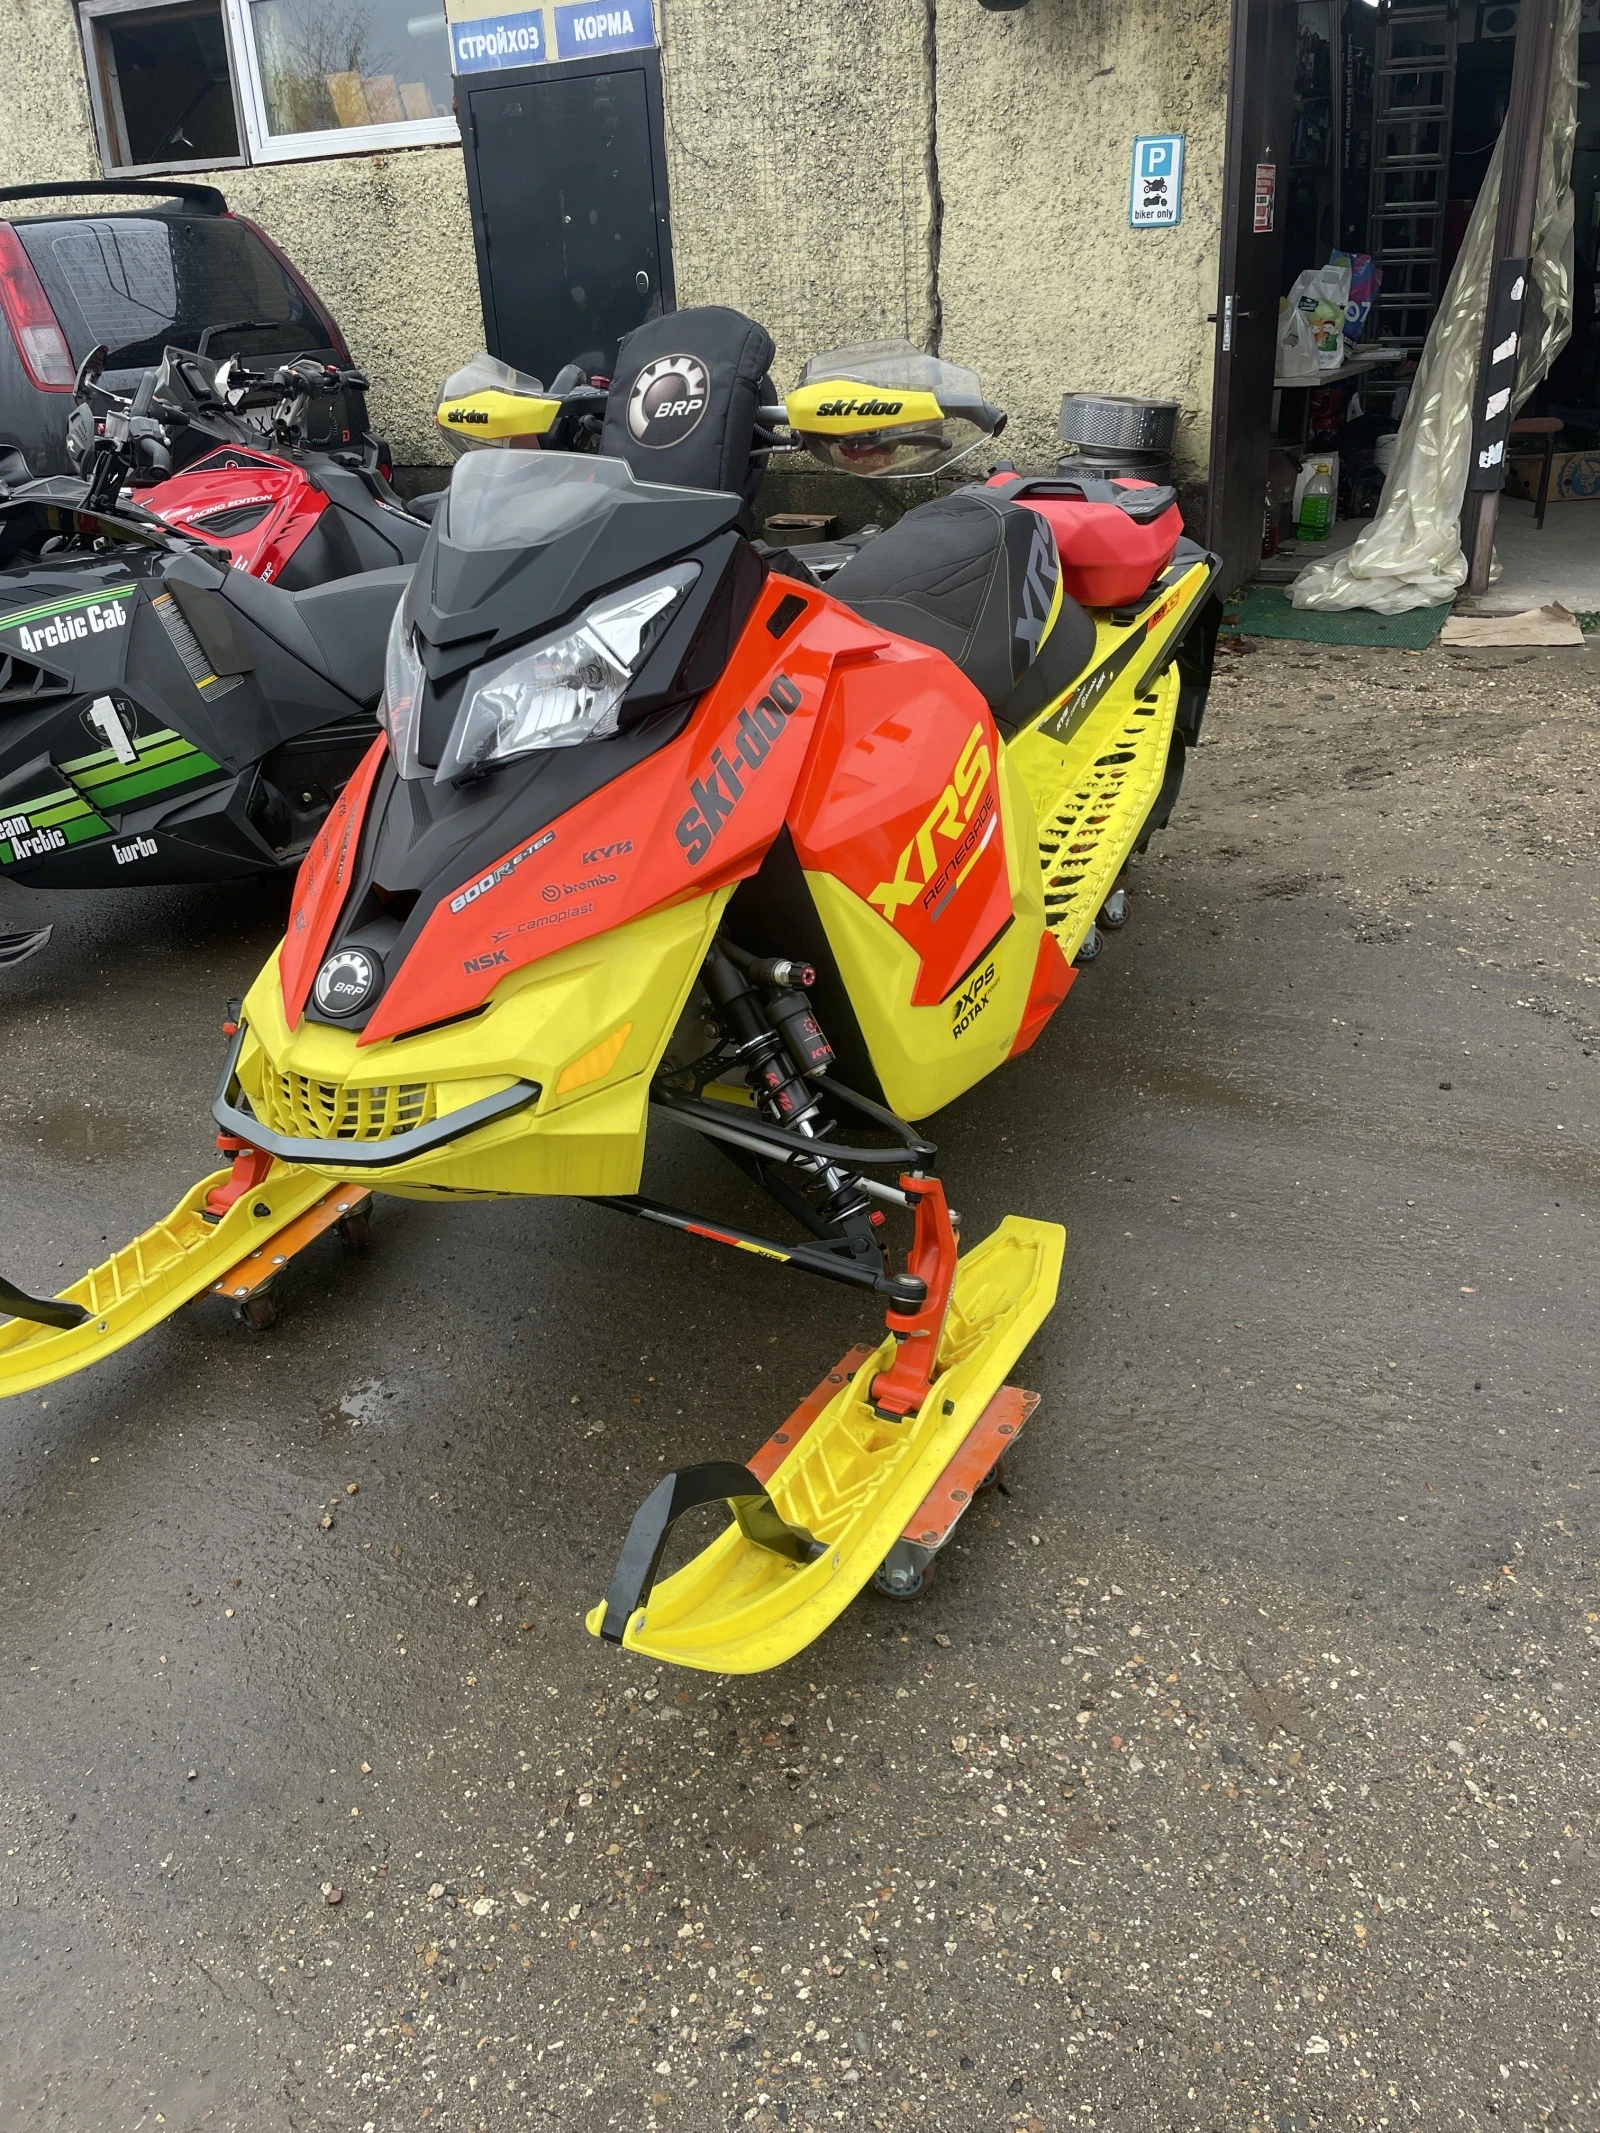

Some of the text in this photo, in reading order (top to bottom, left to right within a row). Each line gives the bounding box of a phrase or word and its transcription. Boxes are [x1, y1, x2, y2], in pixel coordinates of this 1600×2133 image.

[573, 10, 635, 42] КОРМА
[458, 25, 540, 60] СТРОЙХОЗ
[1148, 147, 1166, 173] P
[1134, 208, 1174, 220] biker only
[447, 408, 489, 425] ski-doo
[653, 399, 703, 418] BRP
[816, 398, 904, 417] ski-doo
[186, 504, 226, 522] RACING
[227, 494, 273, 508] EDITION
[18, 600, 127, 654] Arctic Cat
[674, 672, 803, 867] ski-doo
[0, 815, 31, 840] eam
[866, 721, 992, 923] XRS
[10, 827, 66, 861] Arctic
[111, 836, 159, 866] turbo
[582, 840, 633, 865] KYB
[922, 791, 995, 910] RENEGADE
[450, 831, 557, 915] 800R E-TEC
[563, 873, 618, 896] brembo
[516, 902, 594, 933] camoplast
[463, 949, 511, 975] NSK
[333, 982, 365, 996] BRP
[961, 962, 995, 1013] XPS
[952, 993, 990, 1040] ROTAX
